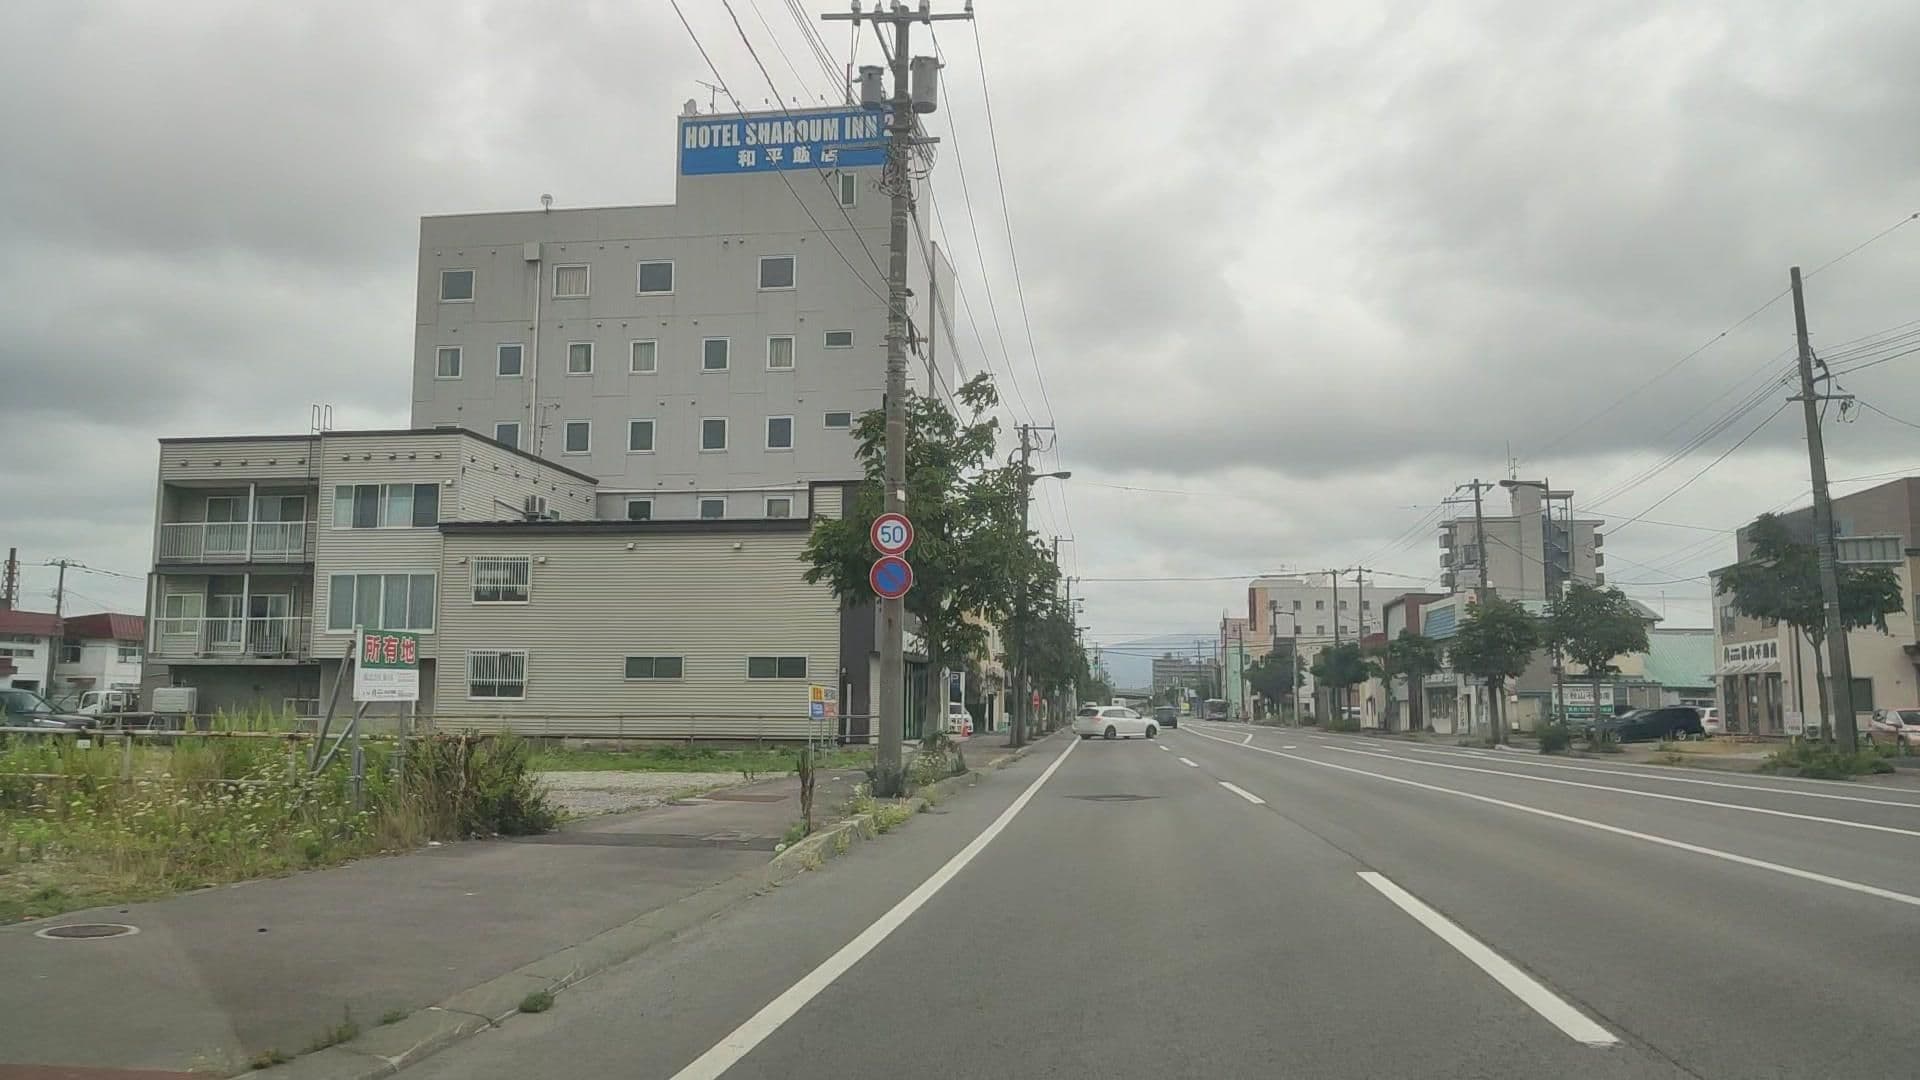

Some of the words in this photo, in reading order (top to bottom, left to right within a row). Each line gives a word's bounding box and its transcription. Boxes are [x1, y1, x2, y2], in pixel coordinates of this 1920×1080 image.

[685, 122, 741, 149] HOTEL
[745, 118, 839, 146] SHAROUM
[845, 115, 878, 139] INN
[881, 526, 904, 544] 50
[364, 634, 416, 665] 所有地
